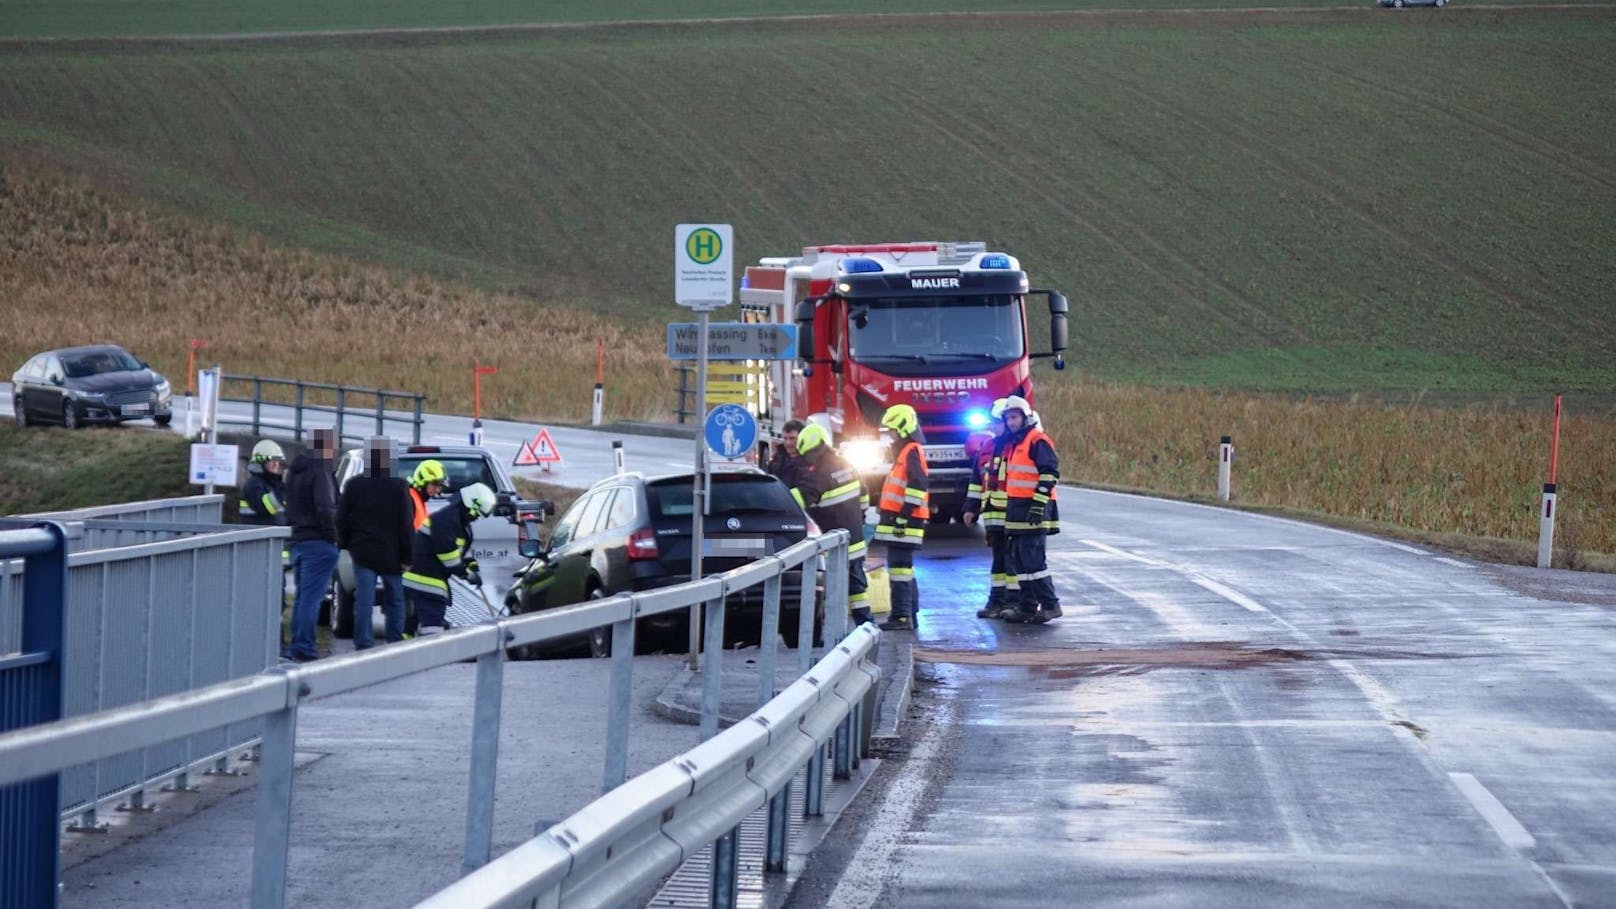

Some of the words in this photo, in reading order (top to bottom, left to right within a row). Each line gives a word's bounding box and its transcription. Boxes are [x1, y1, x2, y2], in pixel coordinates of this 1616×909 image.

[695, 235, 713, 257] H
[911, 278, 960, 288] MAUER
[675, 328, 747, 342] Wimassing
[675, 343, 731, 354] Neuofen
[893, 378, 988, 392] FEUERWEHR
